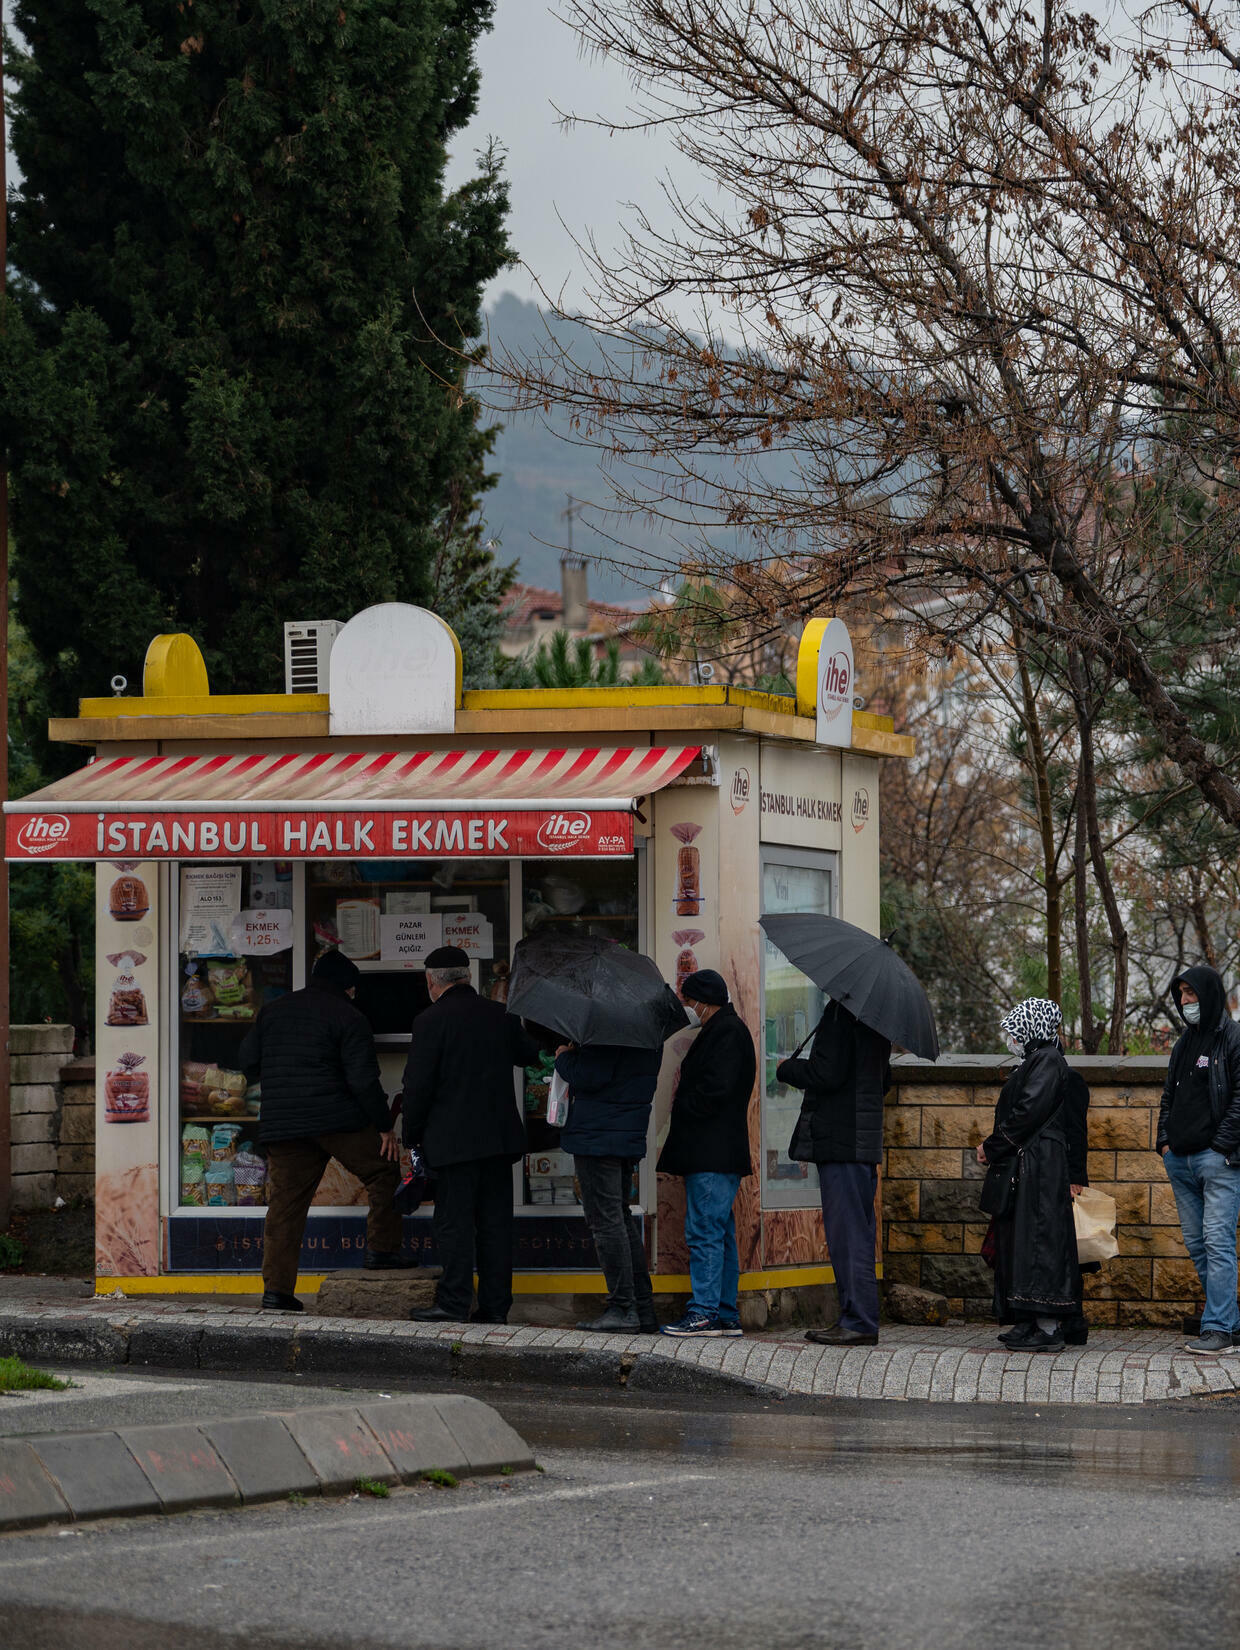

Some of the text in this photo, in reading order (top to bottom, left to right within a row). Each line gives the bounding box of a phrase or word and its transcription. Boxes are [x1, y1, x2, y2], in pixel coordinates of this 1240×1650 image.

[825, 657, 848, 695] ihe
[733, 771, 748, 796] ihe
[760, 786, 841, 823] İSTANBUL HALK EKMEK
[853, 791, 868, 816] ihe
[25, 817, 64, 837] ihe
[97, 813, 510, 852] İSTANBUL HALK EKMEK
[545, 814, 586, 835] ihe
[598, 836, 625, 844] AY-PA
[245, 922, 280, 931] EKMEK
[395, 932, 426, 941] GÜNLERİ
[445, 925, 479, 936] EKMEK
[246, 934, 271, 948] 1,25
